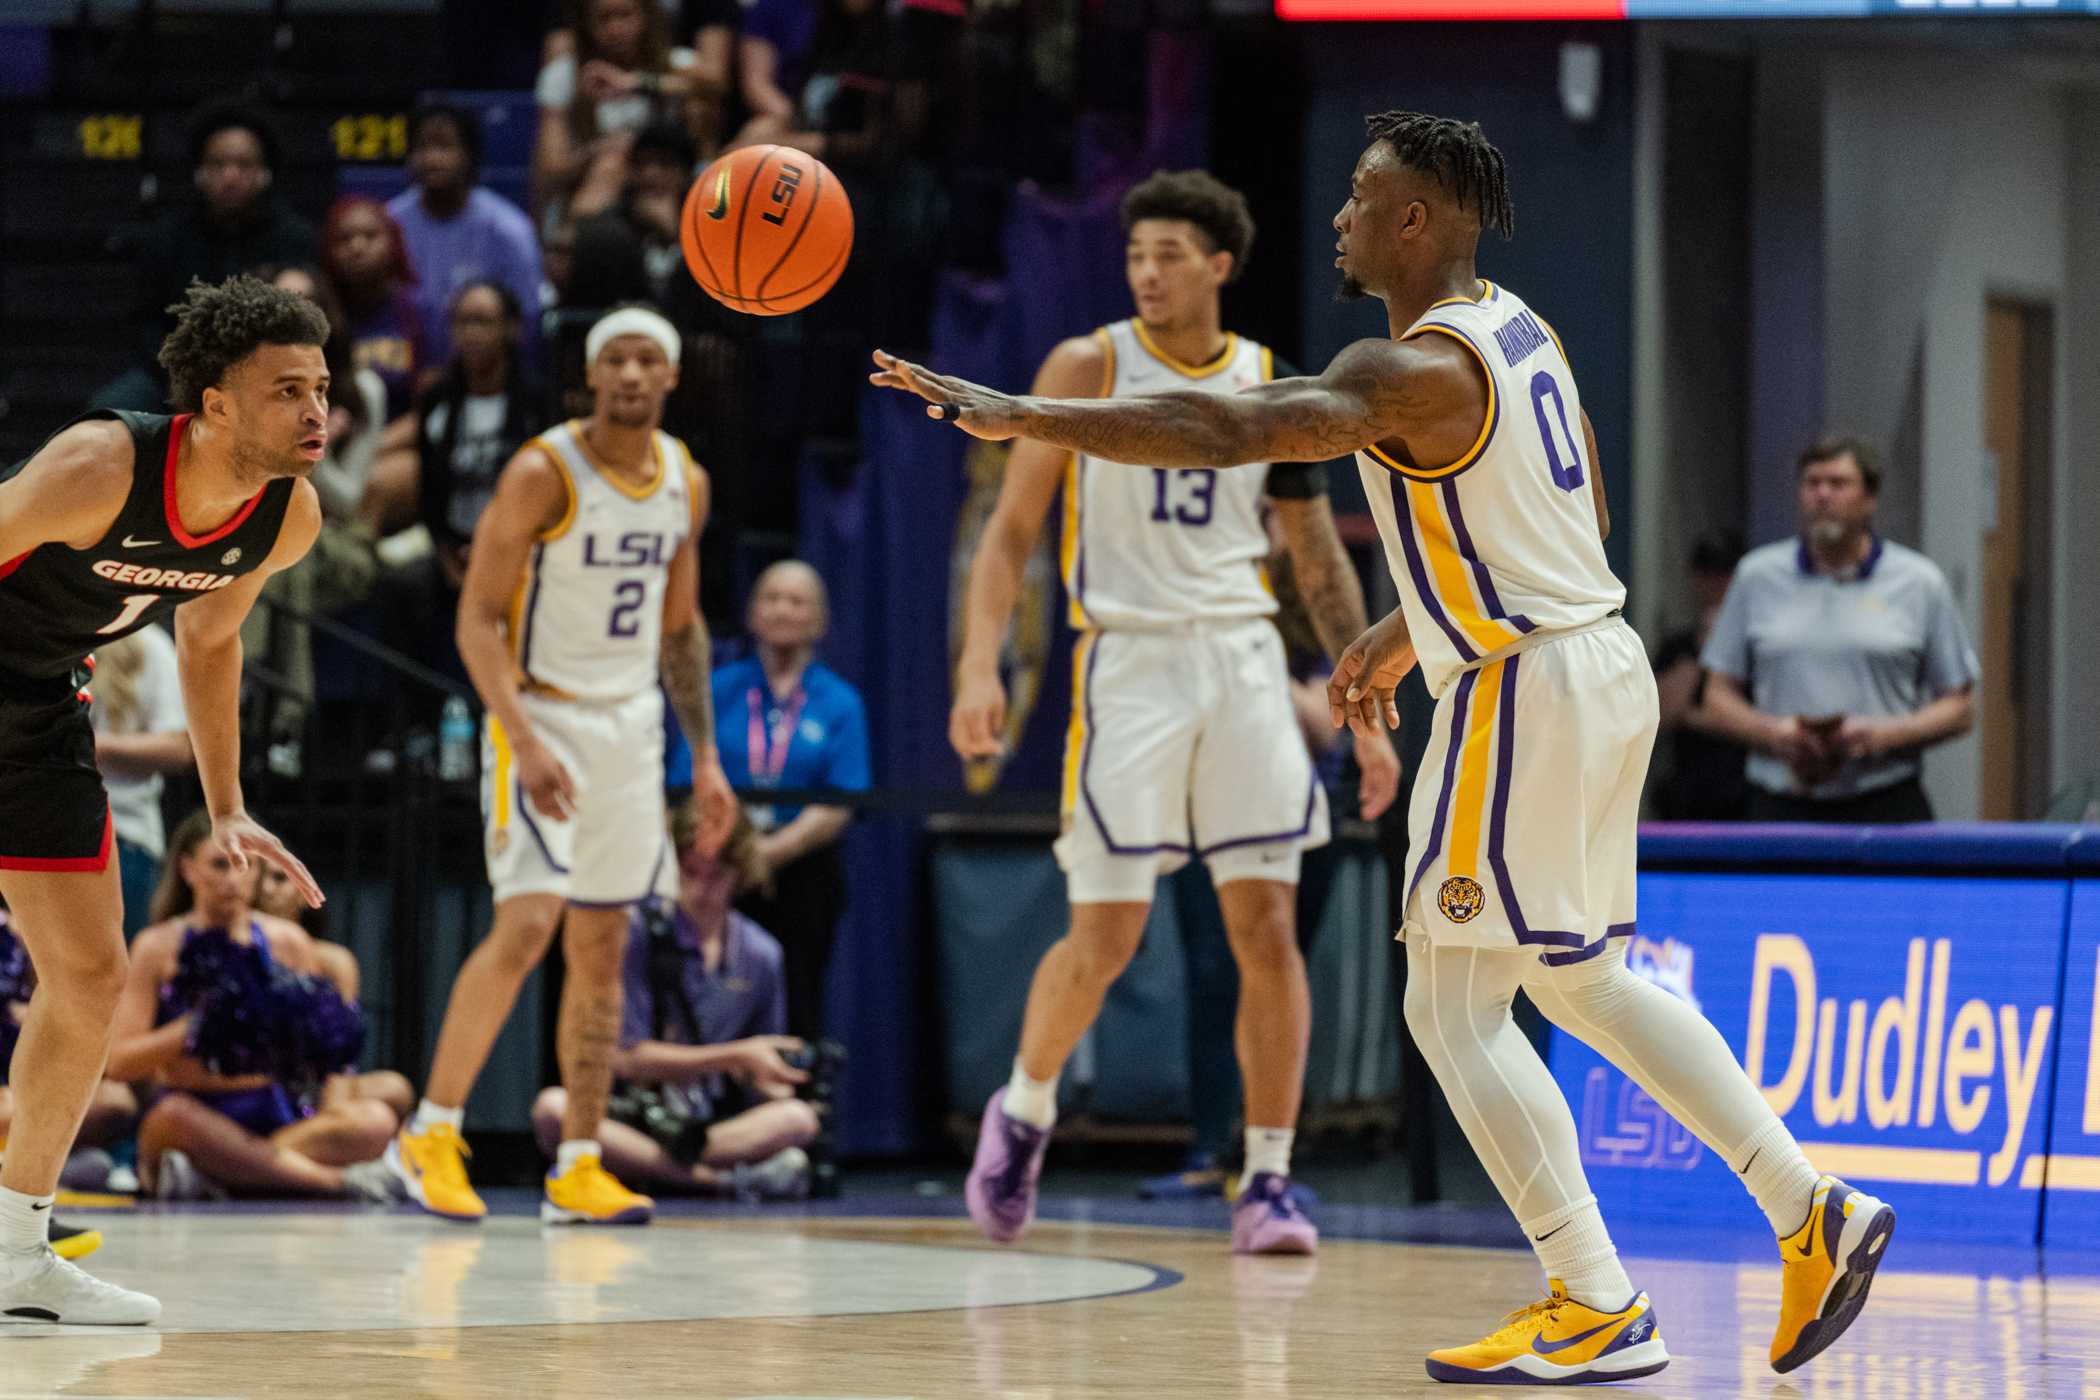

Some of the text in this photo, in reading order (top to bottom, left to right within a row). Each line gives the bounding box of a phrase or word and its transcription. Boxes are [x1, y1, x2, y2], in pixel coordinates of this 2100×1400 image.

[762, 163, 803, 227] LSU
[1530, 370, 1585, 493] 0
[1151, 467, 1217, 526] 13
[96, 593, 161, 634] 1
[609, 581, 645, 637] 2
[1746, 933, 2055, 1187] Dudley
